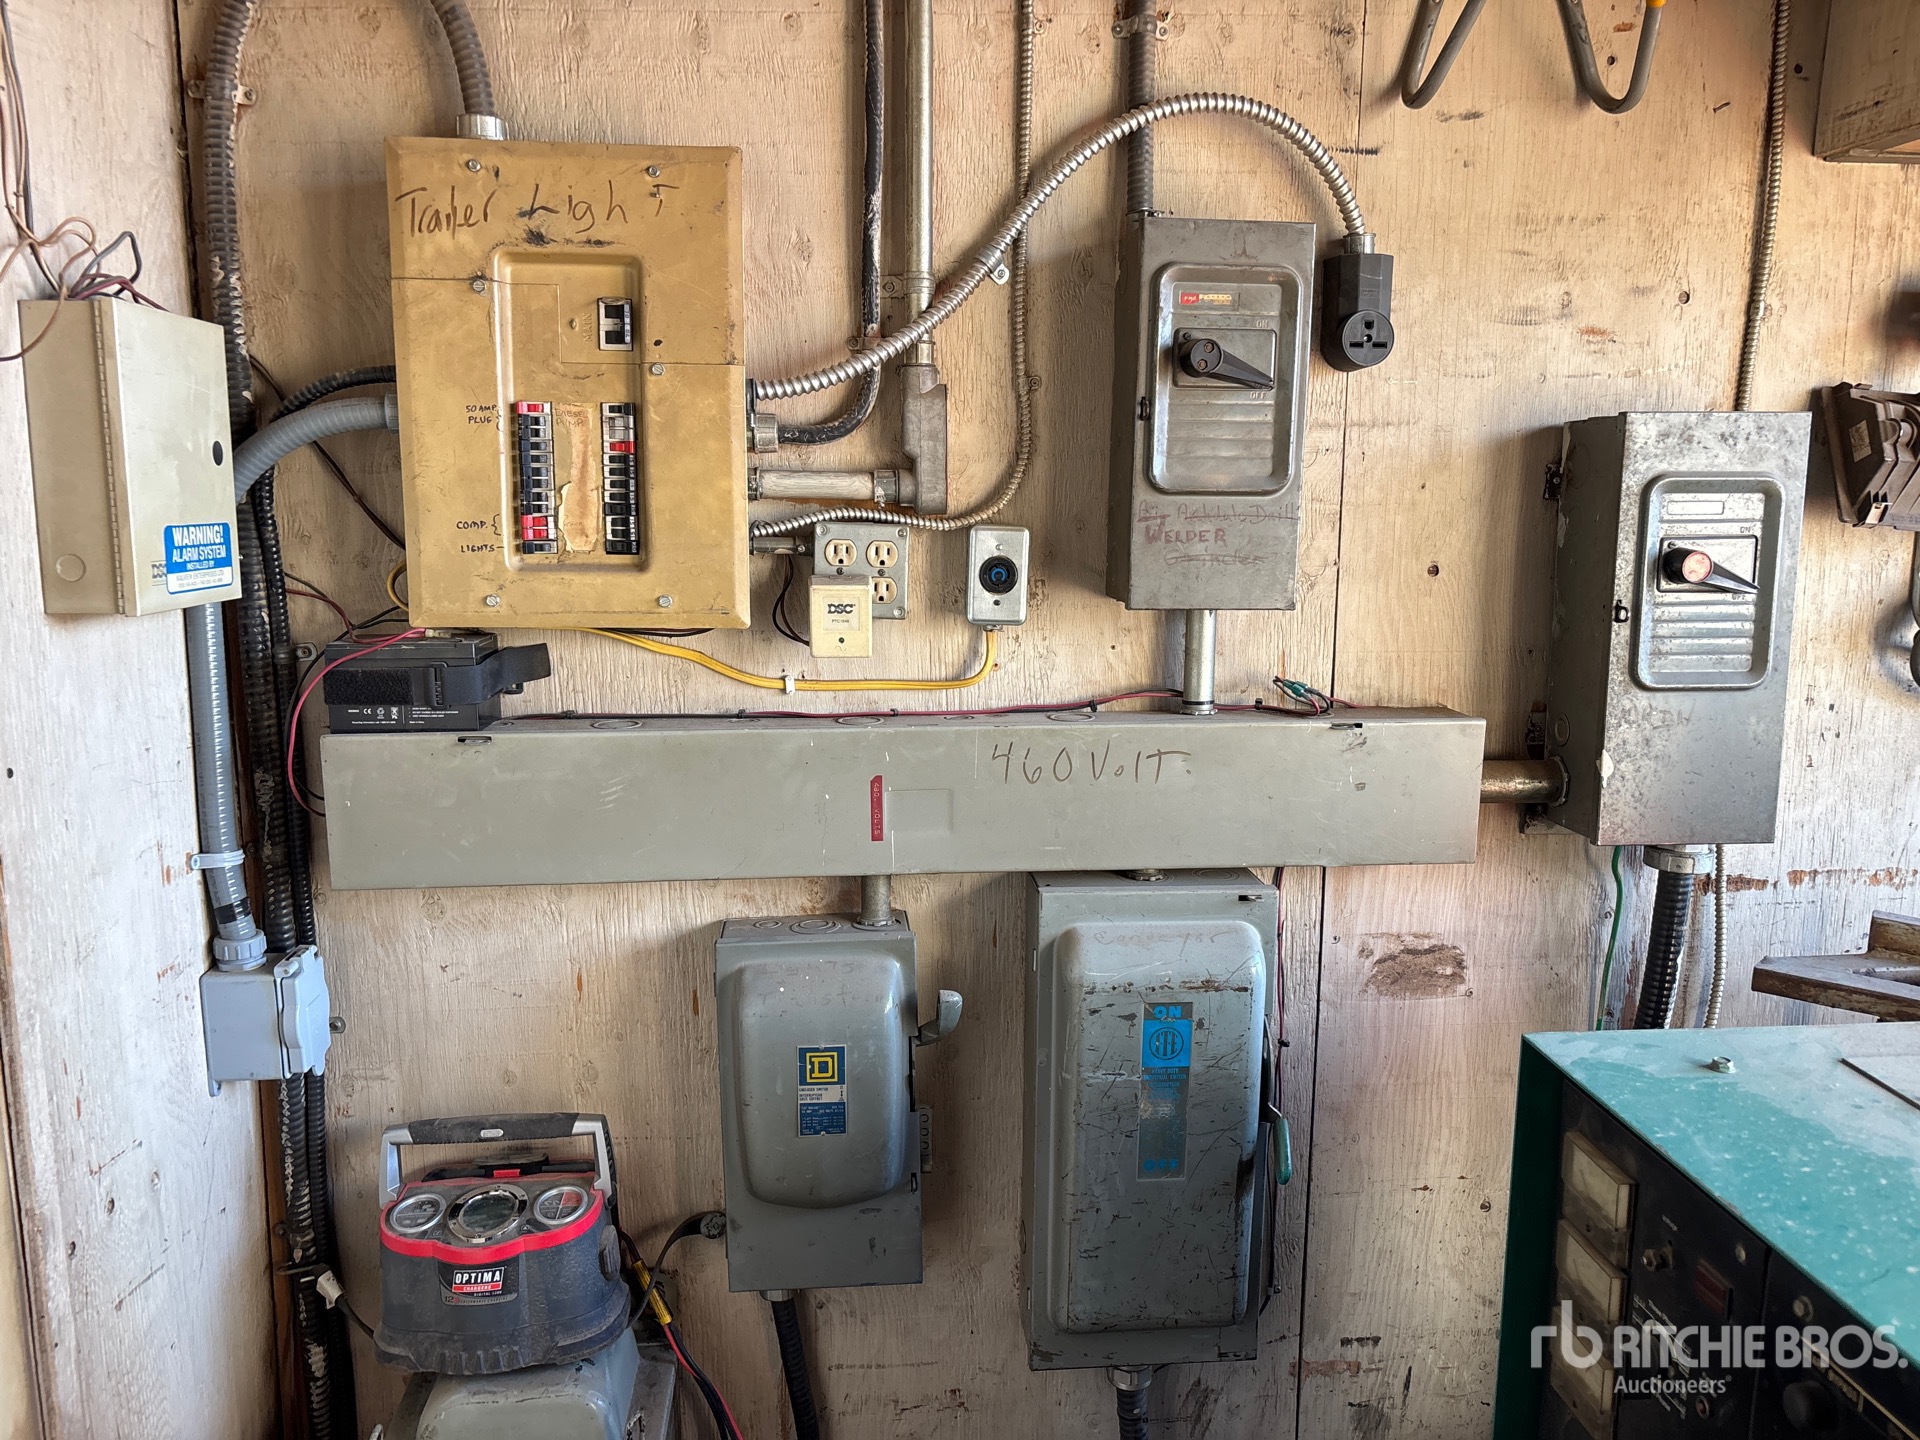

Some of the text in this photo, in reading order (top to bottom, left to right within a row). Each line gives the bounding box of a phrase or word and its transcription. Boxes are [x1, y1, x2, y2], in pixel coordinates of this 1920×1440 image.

[395, 184, 498, 239] Trailer
[1256, 320, 1269, 329] ON
[1250, 391, 1267, 400] OFF
[468, 416, 493, 425] PLUG
[172, 525, 223, 546] WARNING!
[1144, 519, 1228, 548] WELDER
[172, 545, 226, 563] ALARM SYSTEM
[460, 543, 496, 553] LIGHTS
[828, 603, 853, 615] DSC
[992, 741, 1073, 785] 460
[873, 808, 881, 835] VOLTS
[1154, 1006, 1182, 1018] ON
[1155, 1031, 1177, 1056] ITE
[1143, 1158, 1179, 1172] OFF
[456, 1271, 500, 1283] OPTIMA
